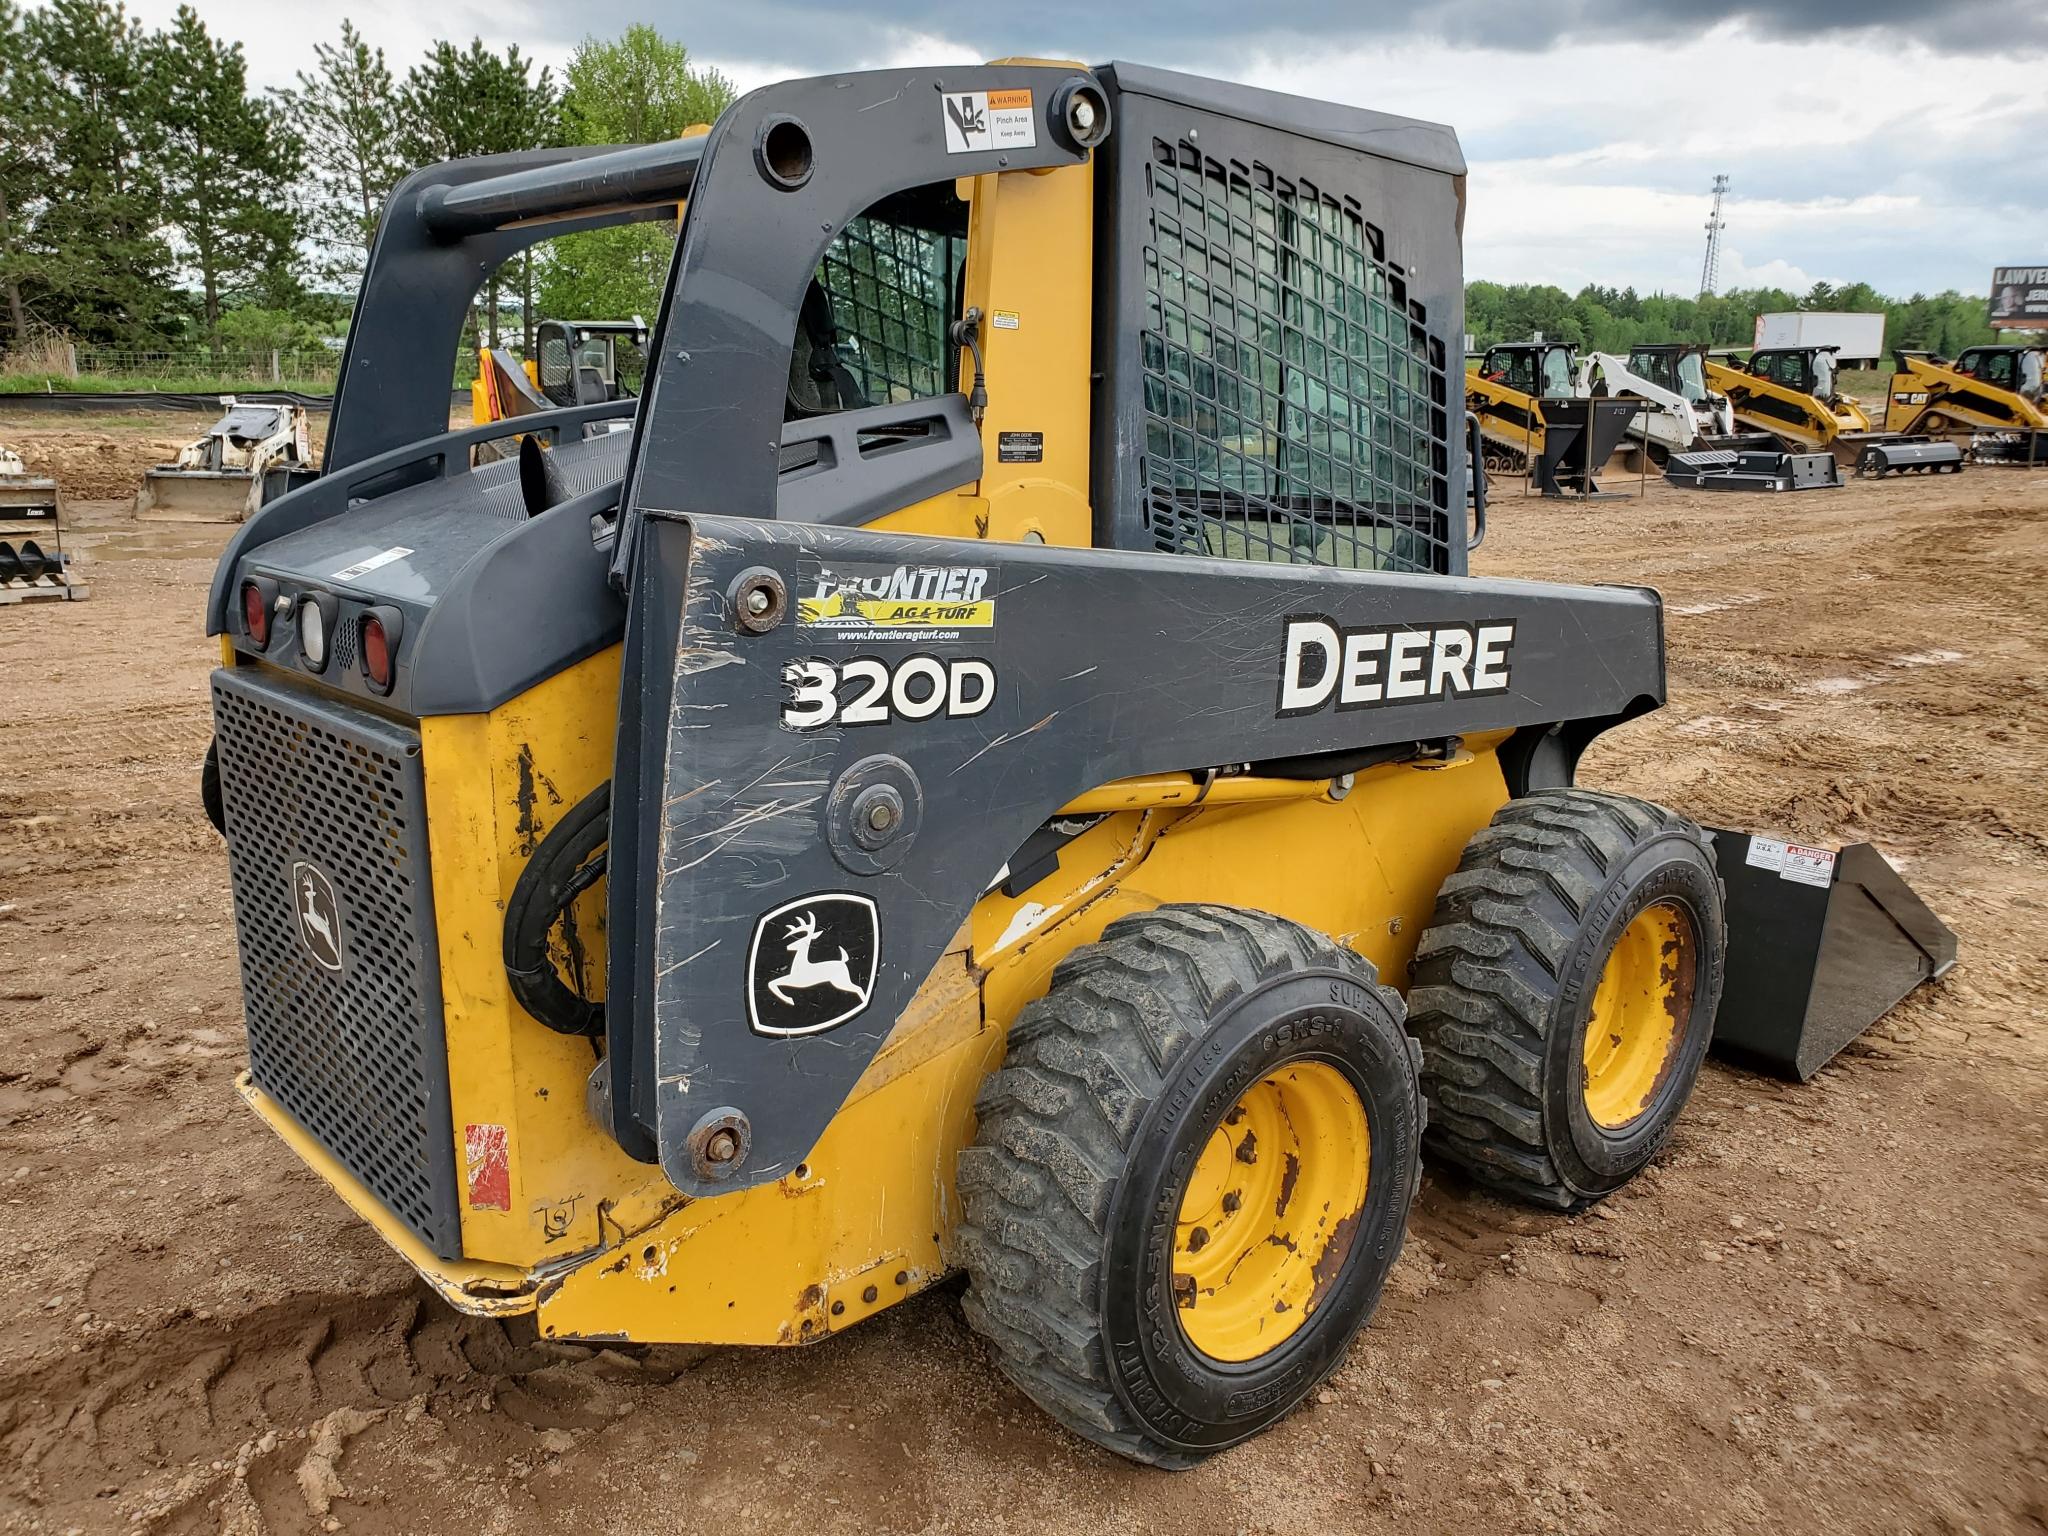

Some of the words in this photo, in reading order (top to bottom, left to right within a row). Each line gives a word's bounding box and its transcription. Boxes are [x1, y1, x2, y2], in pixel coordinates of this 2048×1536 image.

[996, 95, 1028, 105] WARNING
[996, 116, 1012, 124] Pinch
[1014, 116, 1028, 124] Area
[1996, 269, 2048, 285] LAWYE
[1910, 393, 1928, 405] CAT
[890, 606, 918, 620] AG
[921, 607, 931, 619] &
[936, 607, 977, 620] TURF
[837, 630, 960, 641] www.frontieragturf.com
[1282, 622, 1513, 710] DEERE
[782, 656, 995, 728] 320D
[1797, 848, 1831, 861] DANGER
[1115, 1340, 1182, 1431] STABILITY
